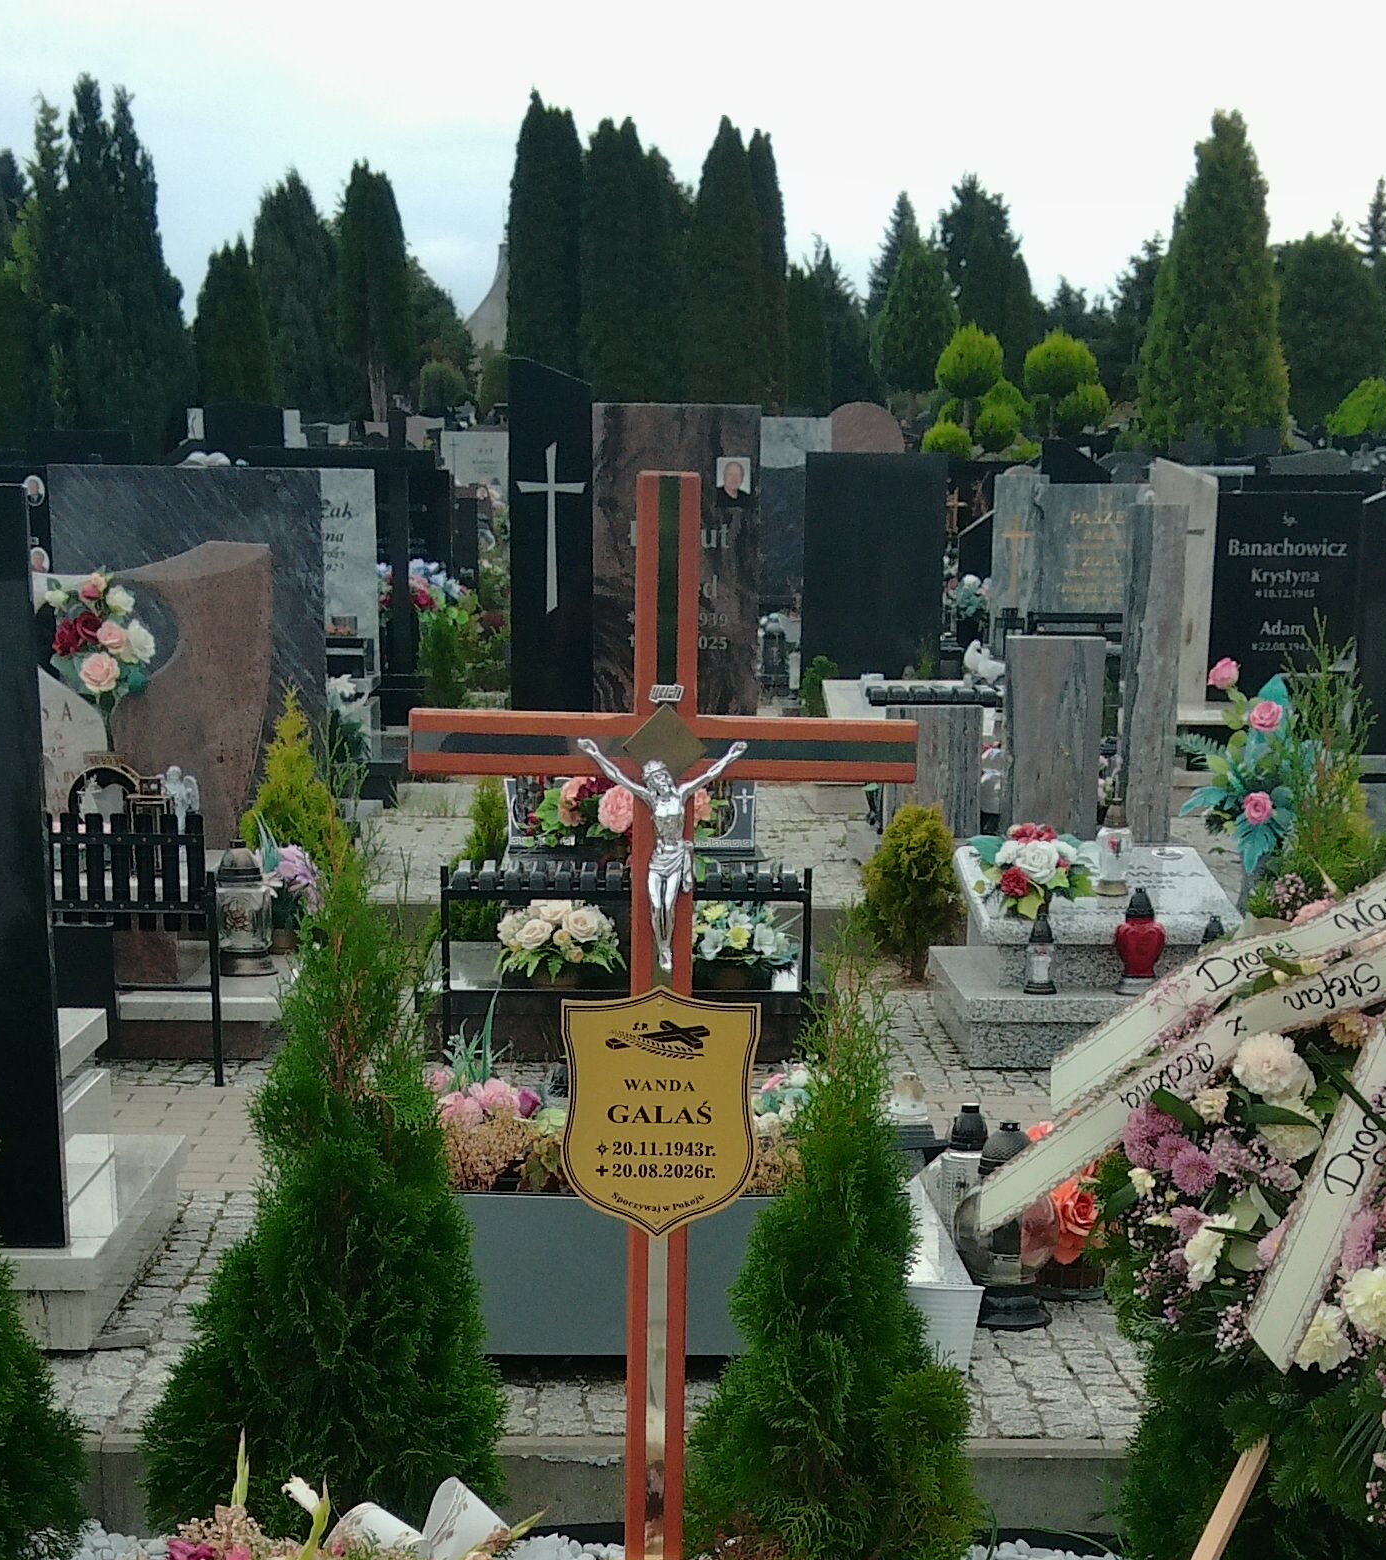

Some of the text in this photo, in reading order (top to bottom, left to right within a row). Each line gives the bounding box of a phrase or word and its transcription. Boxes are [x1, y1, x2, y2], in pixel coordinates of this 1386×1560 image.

[1228, 537, 1348, 557] Banachowicz
[1250, 567, 1320, 587] Krystyna
[1260, 619, 1305, 636] Adam
[1283, 962, 1381, 1010] Stefan
[623, 1079, 696, 1092] WANDA
[607, 1100, 712, 1125] GALAŚ
[612, 1141, 716, 1157] 20.11.1943r.
[612, 1163, 716, 1178] 20.08.2026r.
[611, 1192, 661, 1213] Spoczywaj
[672, 1194, 706, 1210] Pokoju
